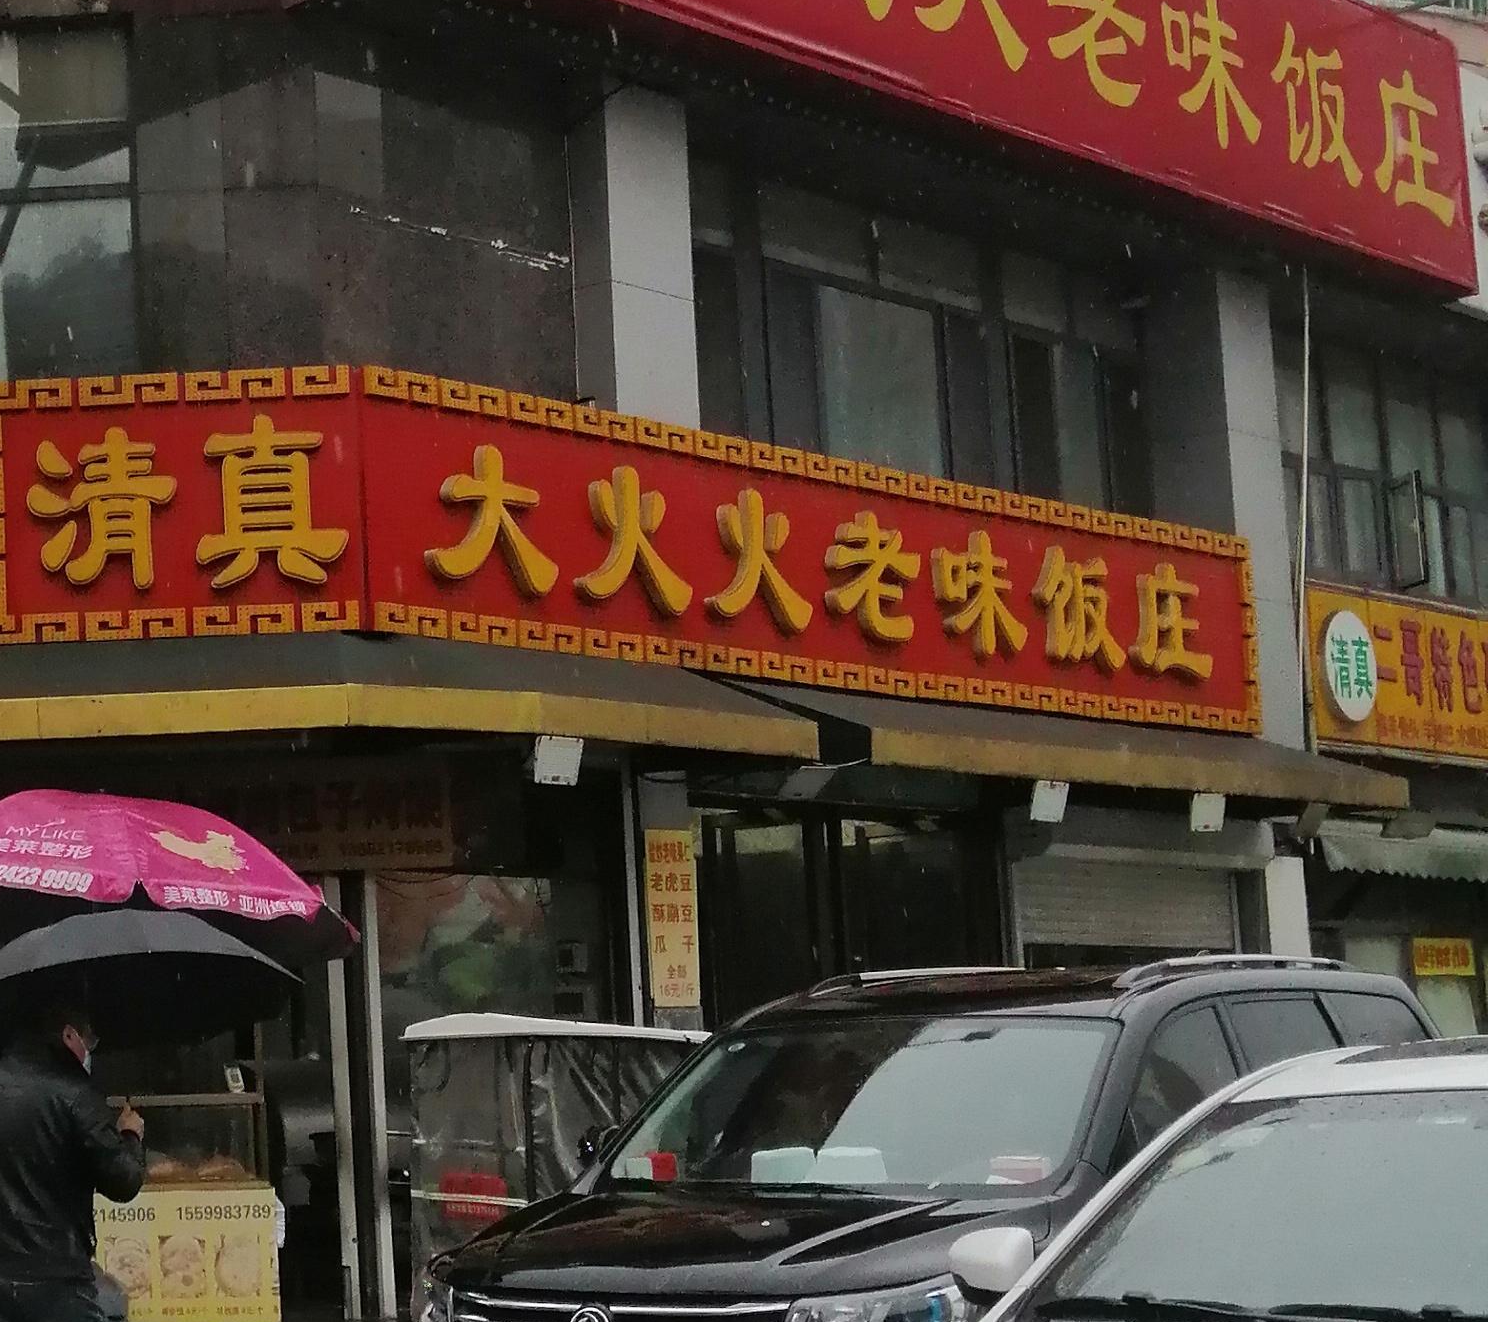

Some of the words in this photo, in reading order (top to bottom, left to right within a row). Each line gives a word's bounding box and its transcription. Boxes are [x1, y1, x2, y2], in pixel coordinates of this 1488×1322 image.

[27, 414, 349, 590] 清真
[424, 443, 1213, 682] 大火火老味饭庄
[1331, 635, 1372, 699] 清真
[1374, 619, 1488, 714] 二哥特色
[39, 866, 94, 892] 9999
[650, 872, 692, 892] 老虎豆
[655, 935, 694, 953] 瓜子
[667, 964, 687, 979] 全部
